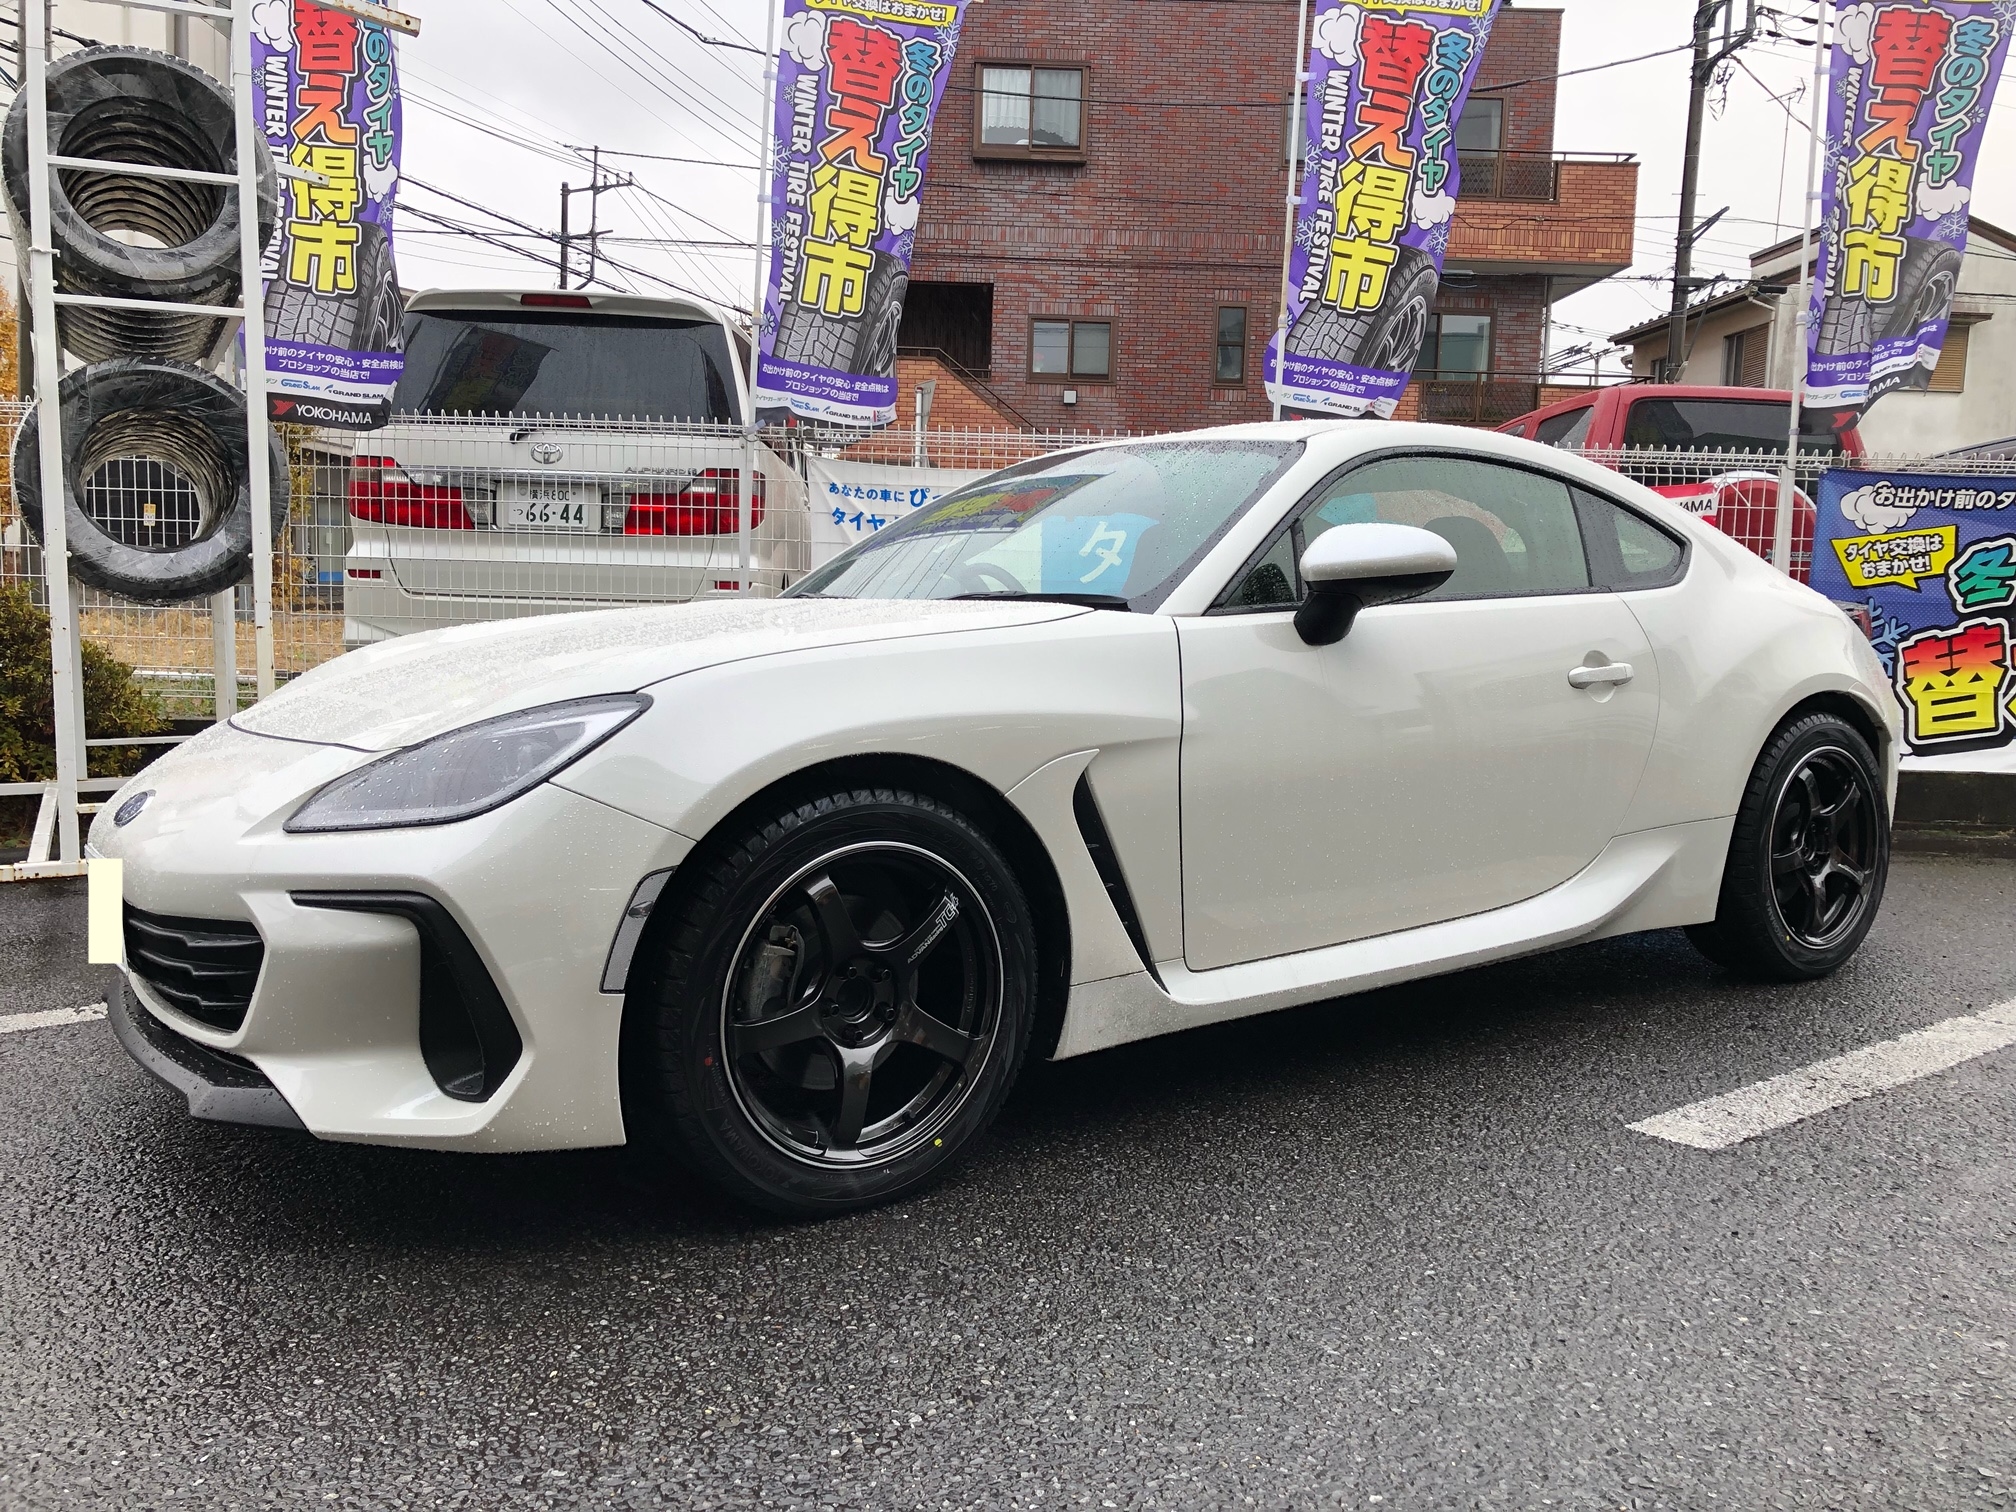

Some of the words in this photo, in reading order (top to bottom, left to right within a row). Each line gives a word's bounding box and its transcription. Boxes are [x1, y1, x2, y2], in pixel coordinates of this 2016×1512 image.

[265, 56, 289, 138] WINTER
[364, 20, 393, 164] のタイヤ
[791, 75, 819, 154] WINTER
[894, 41, 938, 197] 冬のタイヤ
[1321, 70, 1350, 152] WINTER
[1421, 32, 1470, 189] 冬のタイヤ
[1842, 67, 1862, 147] WINTER
[1927, 20, 1995, 183] 冬のタイヤ
[786, 161, 809, 206] TIRE
[801, 19, 901, 314] 替え得市
[1318, 158, 1337, 205] TIRE
[1326, 15, 1433, 310] 替え得市
[1835, 155, 1850, 201] TIRE
[1844, 8, 1952, 300] 替え得市
[778, 211, 804, 304] FESTIVAL
[1299, 208, 1332, 302] FESTIVAL
[279, 359, 370, 380] プロショップの当店で!
[333, 390, 361, 398] GRAND
[1270, 359, 1400, 387] おかけ前のタイヤの安心・安全点検は
[1292, 374, 1366, 394] プロショップの当店で!
[296, 404, 372, 424] YOKOHAMA
[829, 411, 851, 419] GRAND
[1328, 402, 1352, 410] GRAND
[526, 503, 584, 525] 66-44
[1845, 534, 1943, 561] タイヤ交換は
[1860, 555, 1932, 578] おまかせ!
